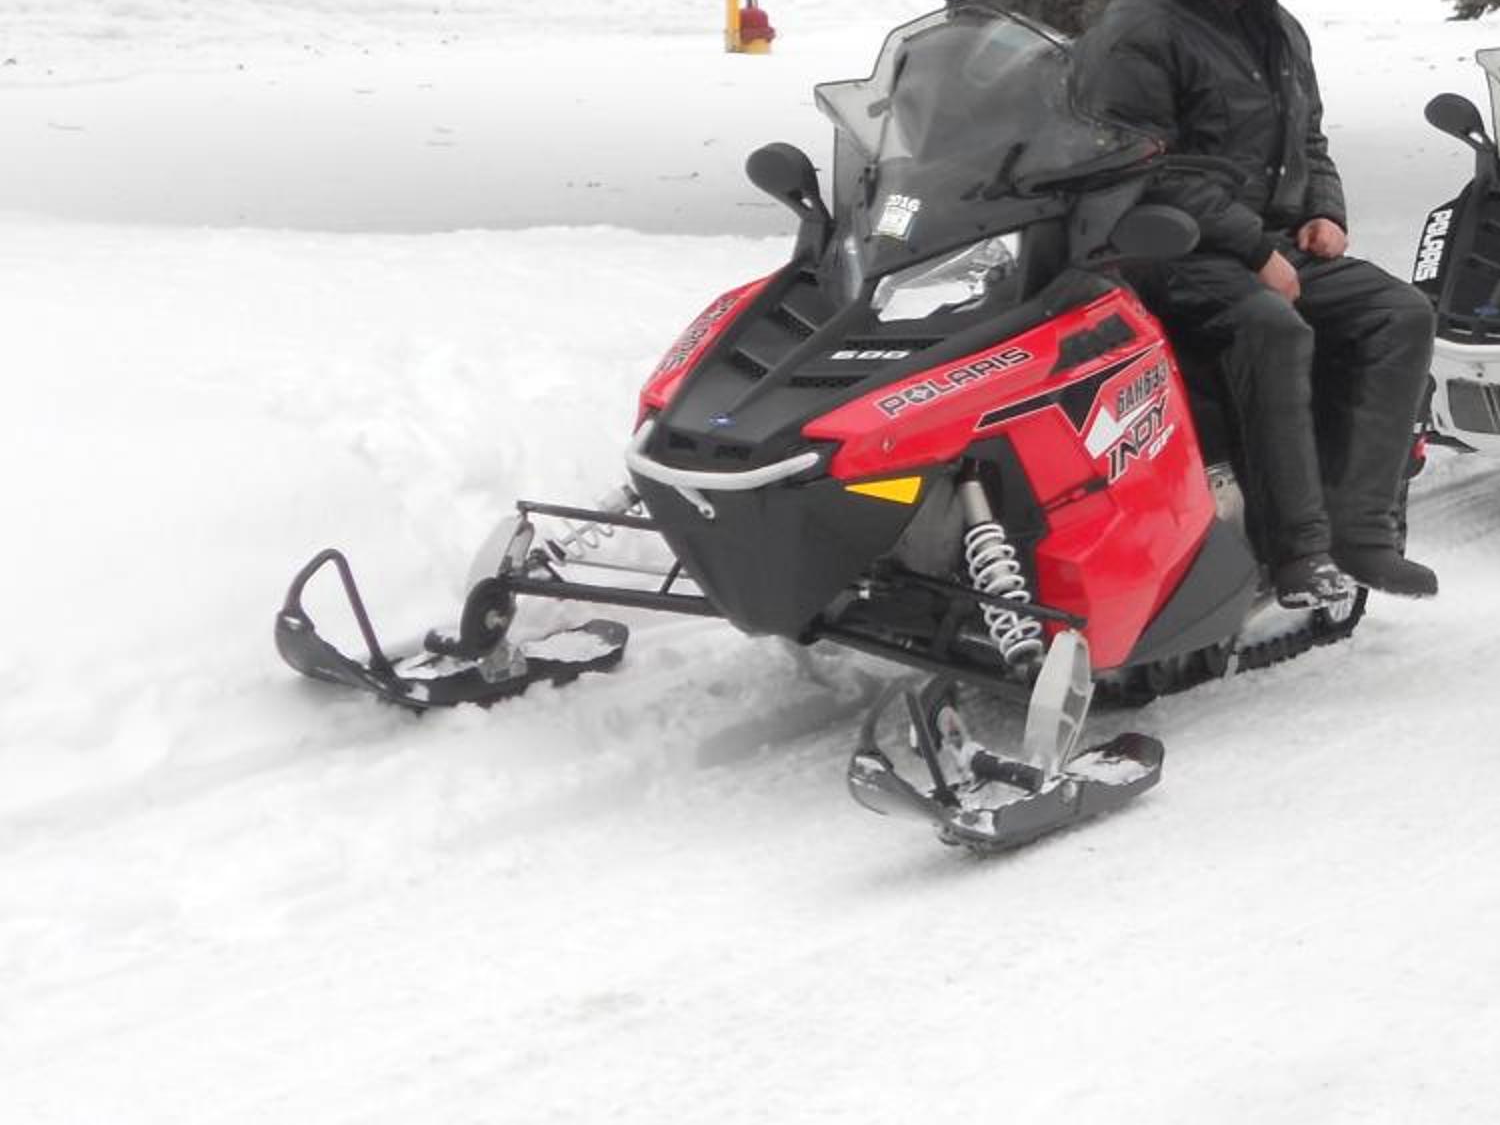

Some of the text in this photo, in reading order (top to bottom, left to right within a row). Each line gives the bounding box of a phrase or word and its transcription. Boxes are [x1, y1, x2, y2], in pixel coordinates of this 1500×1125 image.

[1413, 208, 1453, 282] POLARIS
[830, 349, 911, 360] 600
[873, 346, 1035, 420] POLARIS
[1106, 389, 1170, 485] INDY
